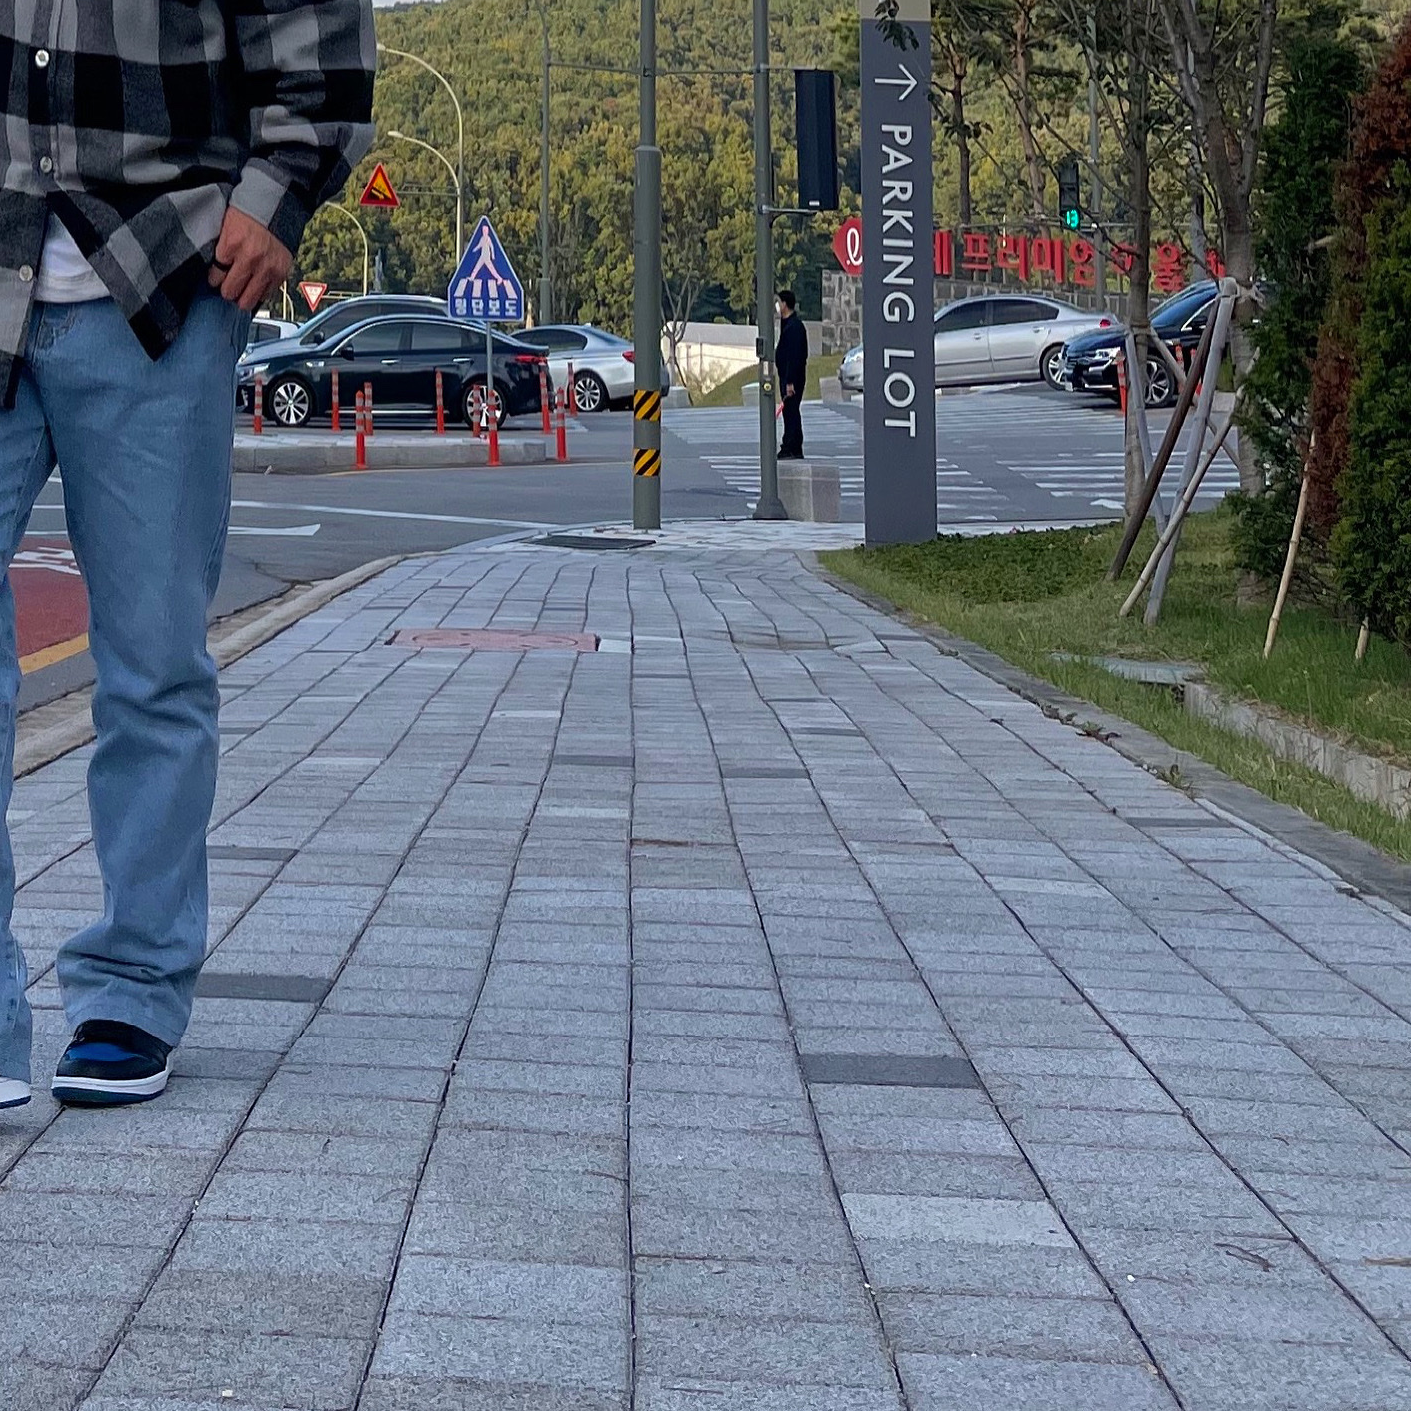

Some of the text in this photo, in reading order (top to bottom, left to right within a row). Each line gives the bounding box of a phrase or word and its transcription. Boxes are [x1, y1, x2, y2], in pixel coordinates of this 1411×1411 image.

[454, 297, 517, 316] 횡단보도
[881, 124, 916, 438] PARKING LOT
